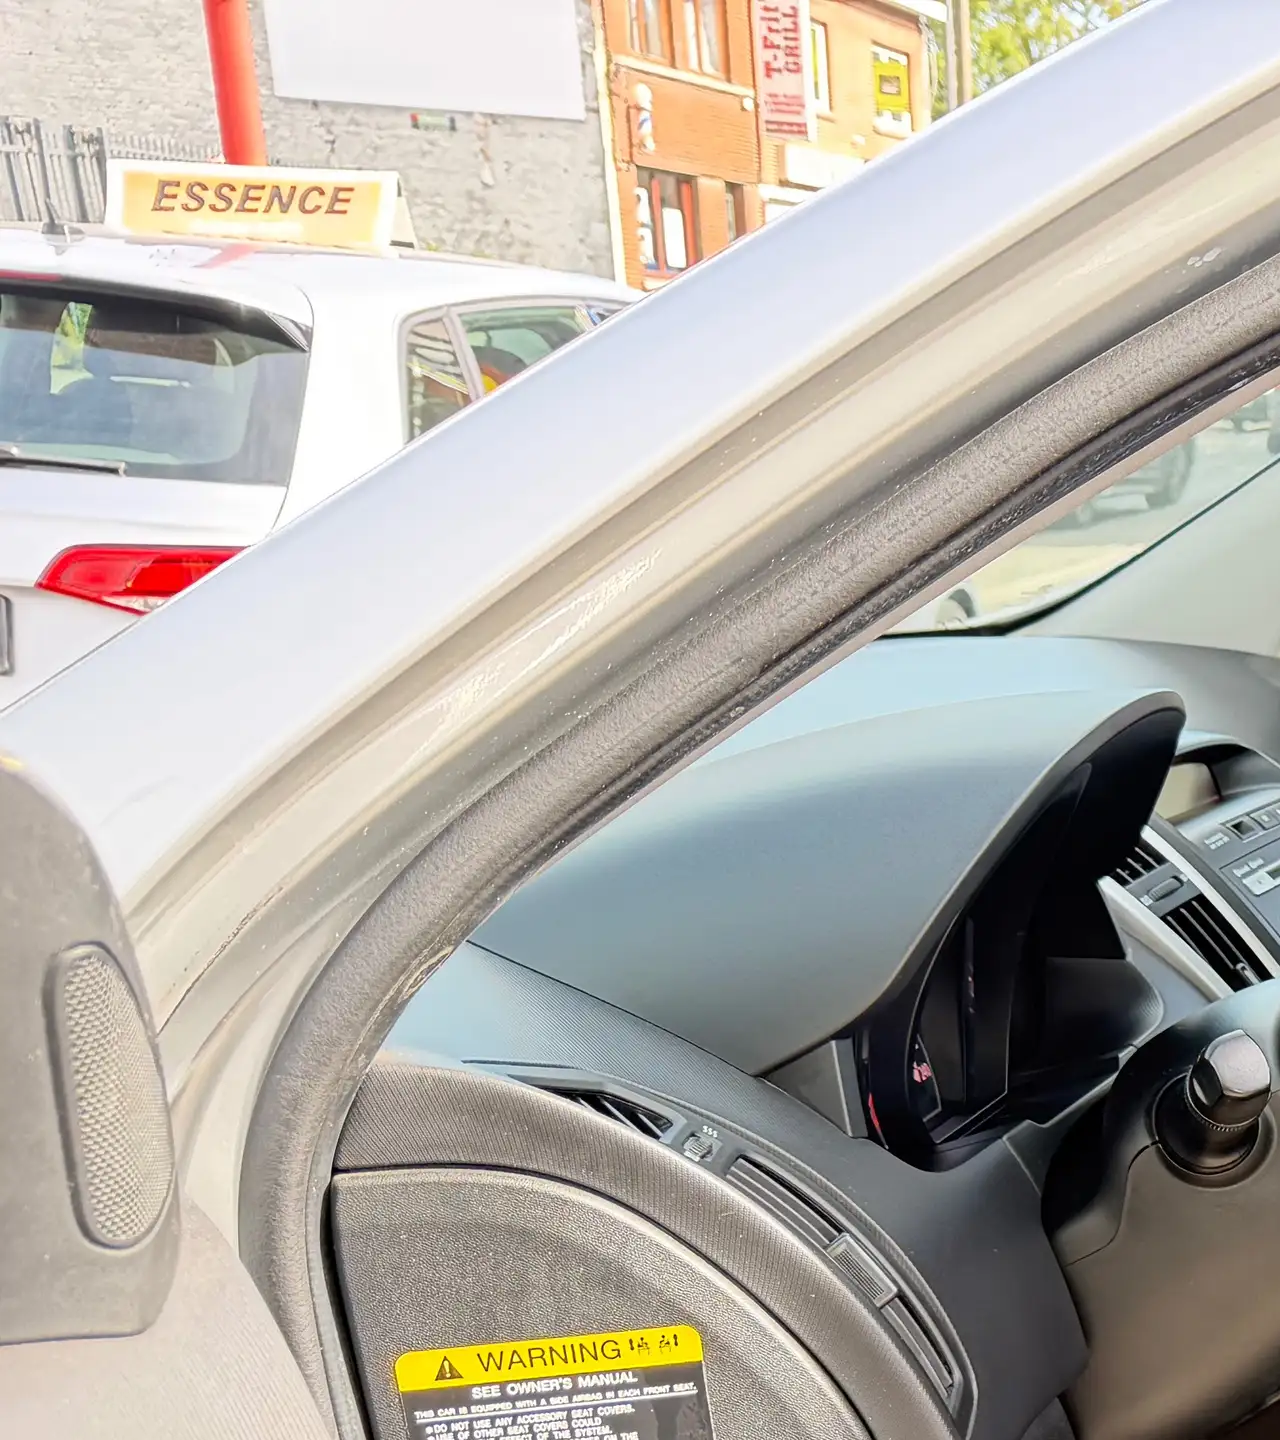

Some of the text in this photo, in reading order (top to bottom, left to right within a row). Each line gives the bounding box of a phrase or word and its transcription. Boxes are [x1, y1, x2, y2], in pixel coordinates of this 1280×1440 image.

[151, 179, 355, 215] ESSENCE
[477, 1340, 621, 1372] WARNING
[470, 1371, 637, 1399] SEE OWNER'S MANUAL
